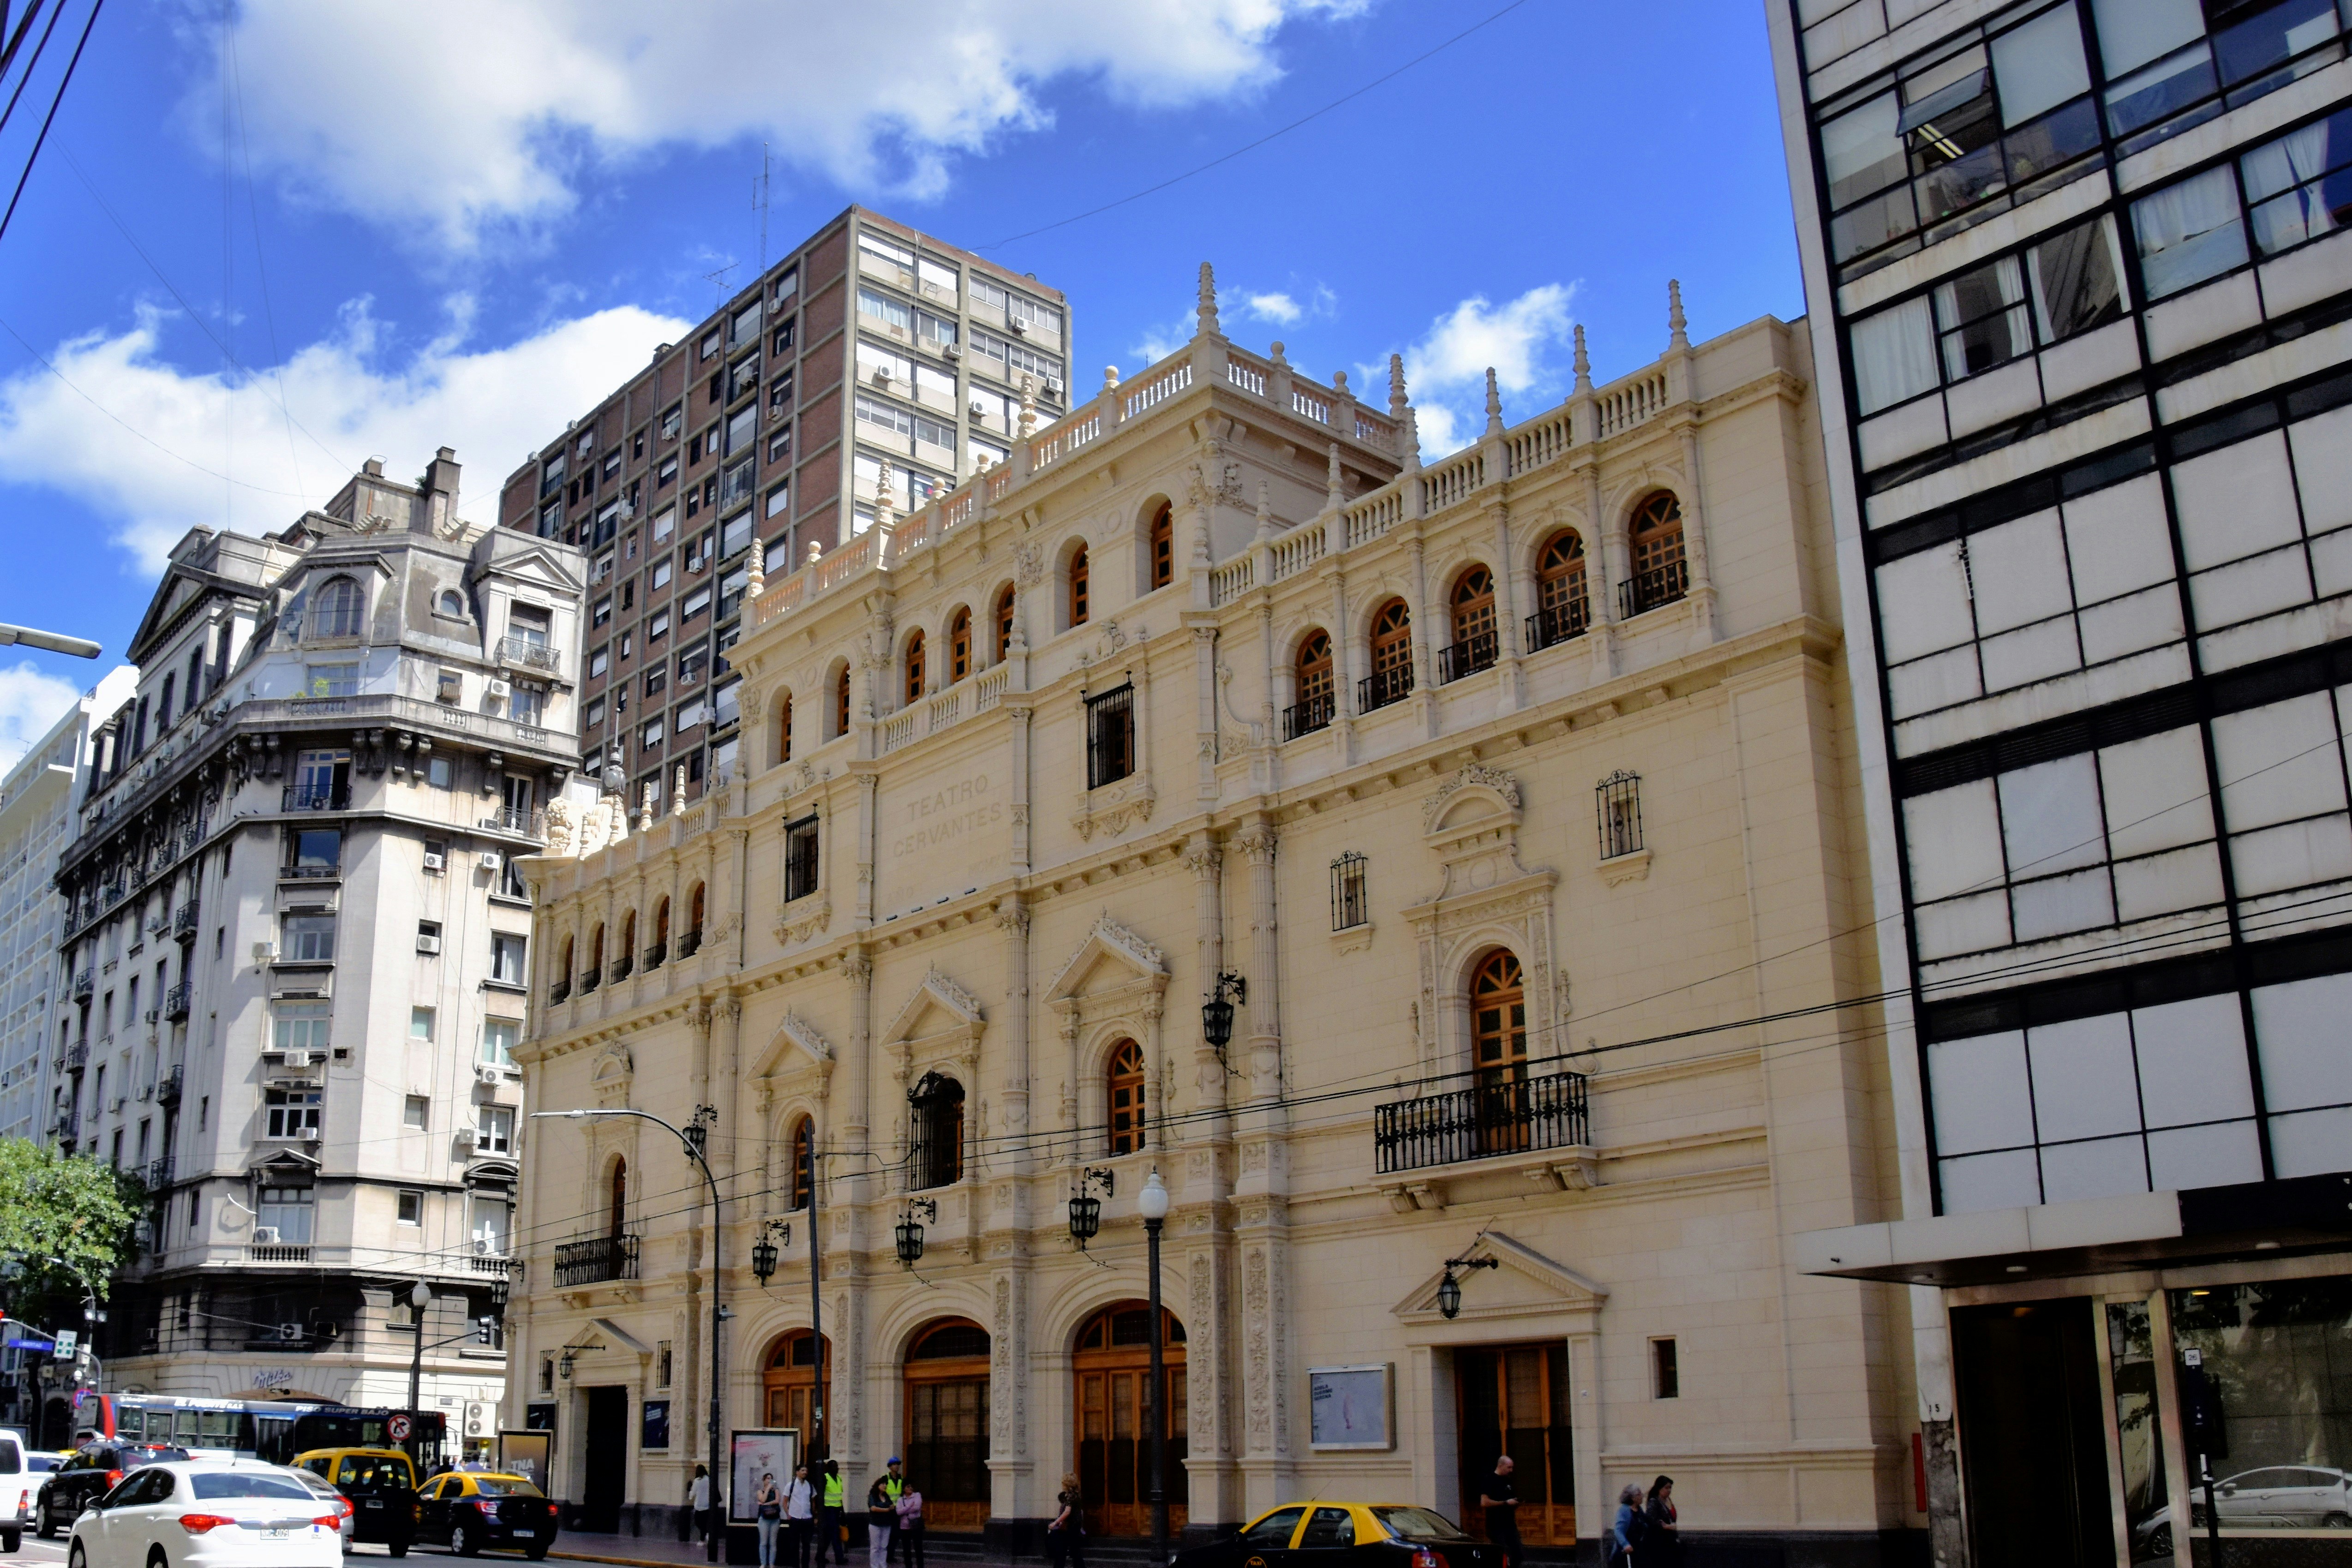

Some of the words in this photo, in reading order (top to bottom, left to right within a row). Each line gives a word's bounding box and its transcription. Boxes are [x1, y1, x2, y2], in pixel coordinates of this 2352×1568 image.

[907, 774, 988, 821] TEATRO
[893, 802, 1002, 857] CERVANTES
[253, 1370, 293, 1388] Milka
[188, 1399, 228, 1408] PUENTE
